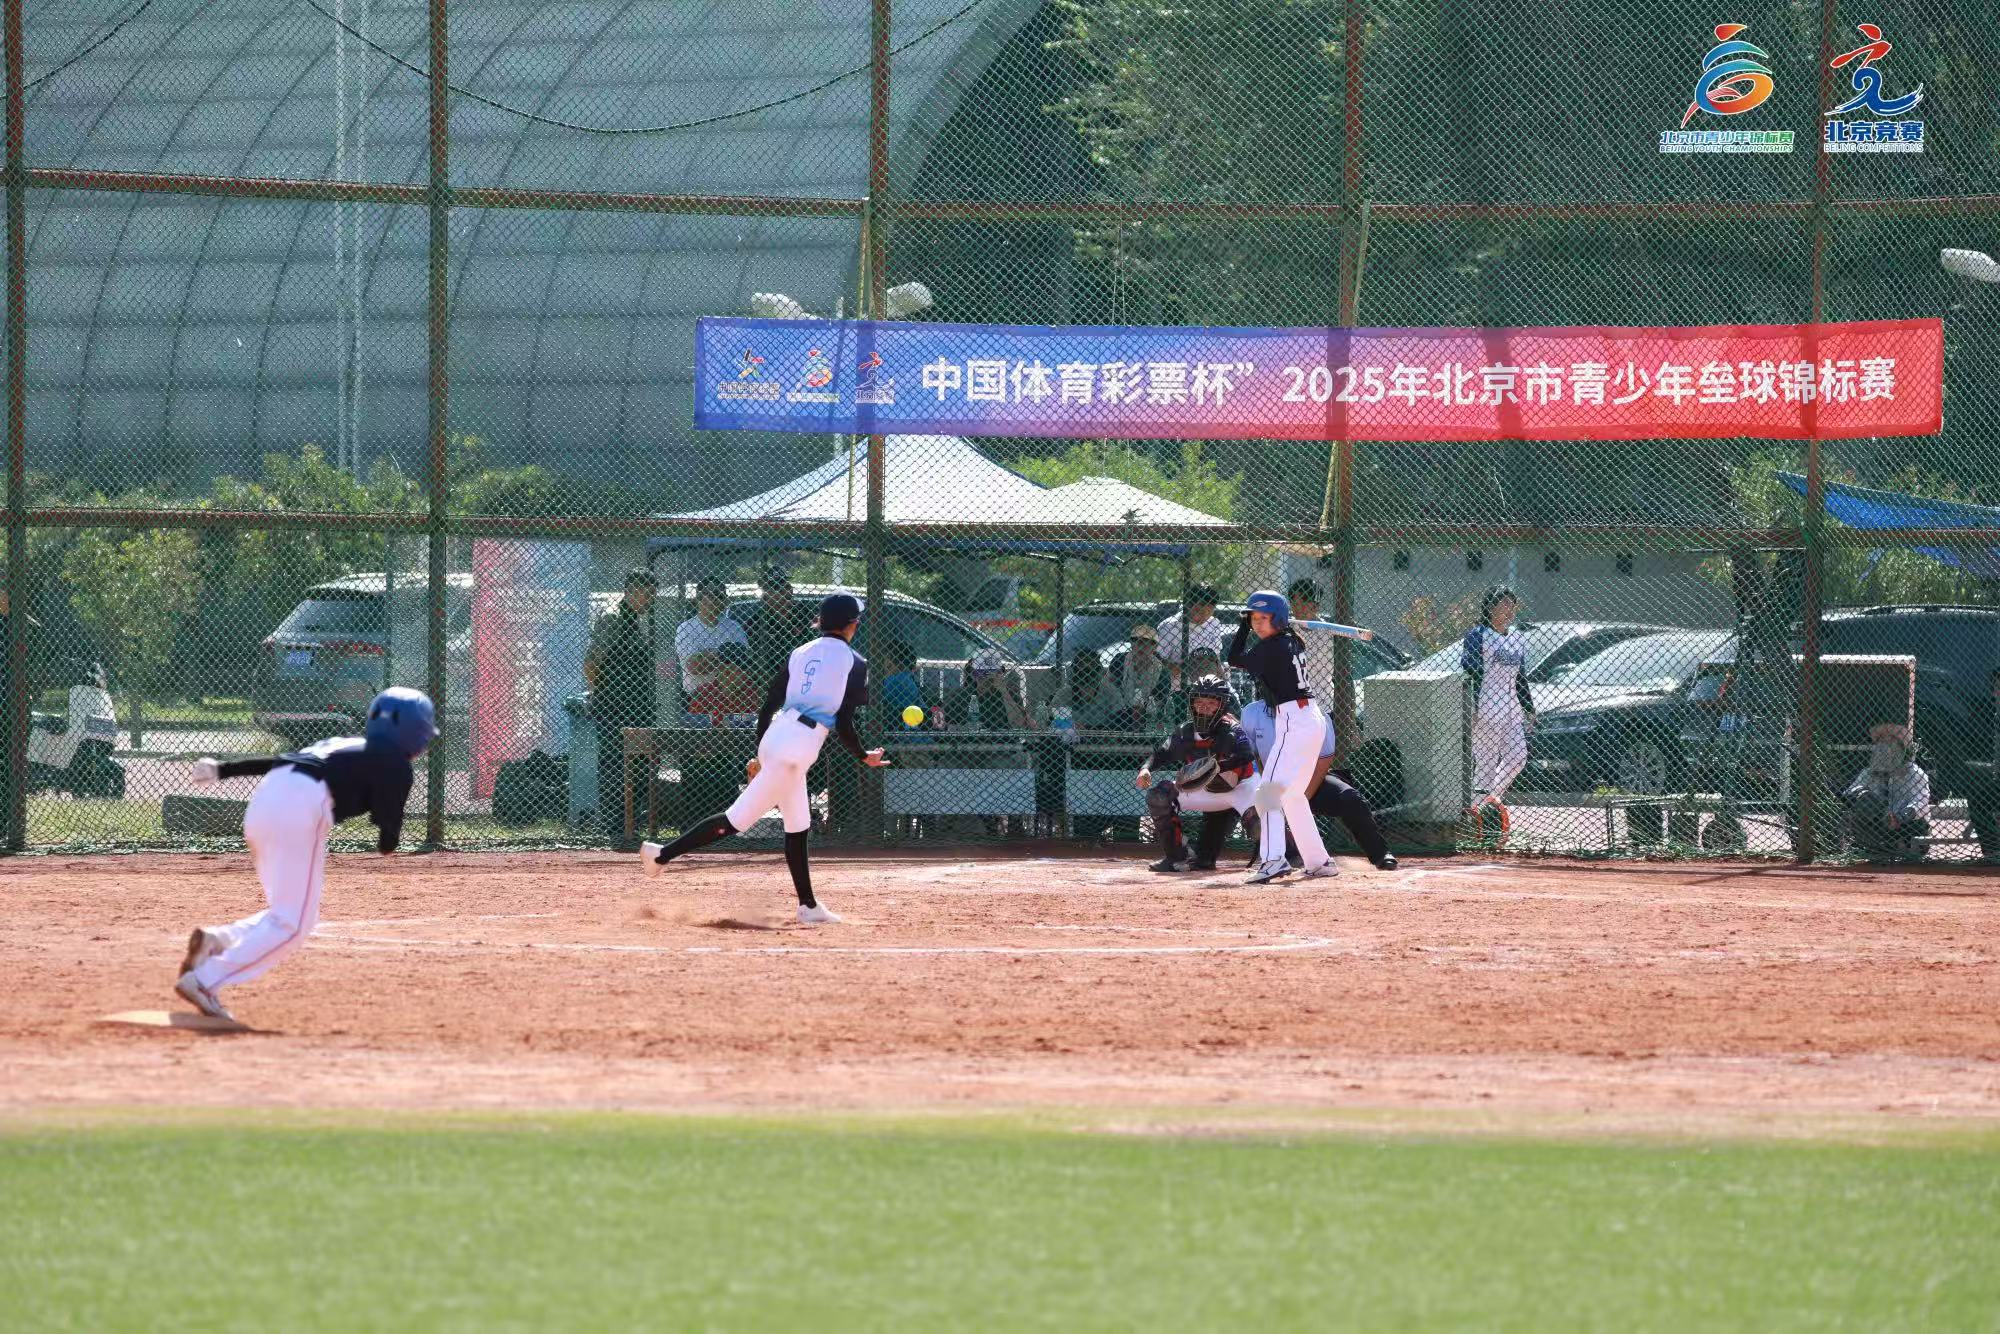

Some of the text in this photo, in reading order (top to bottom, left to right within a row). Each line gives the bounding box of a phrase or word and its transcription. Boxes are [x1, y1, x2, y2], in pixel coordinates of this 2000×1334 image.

[1282, 357, 1896, 407] 2025年北京市青少年垒球锦标赛
